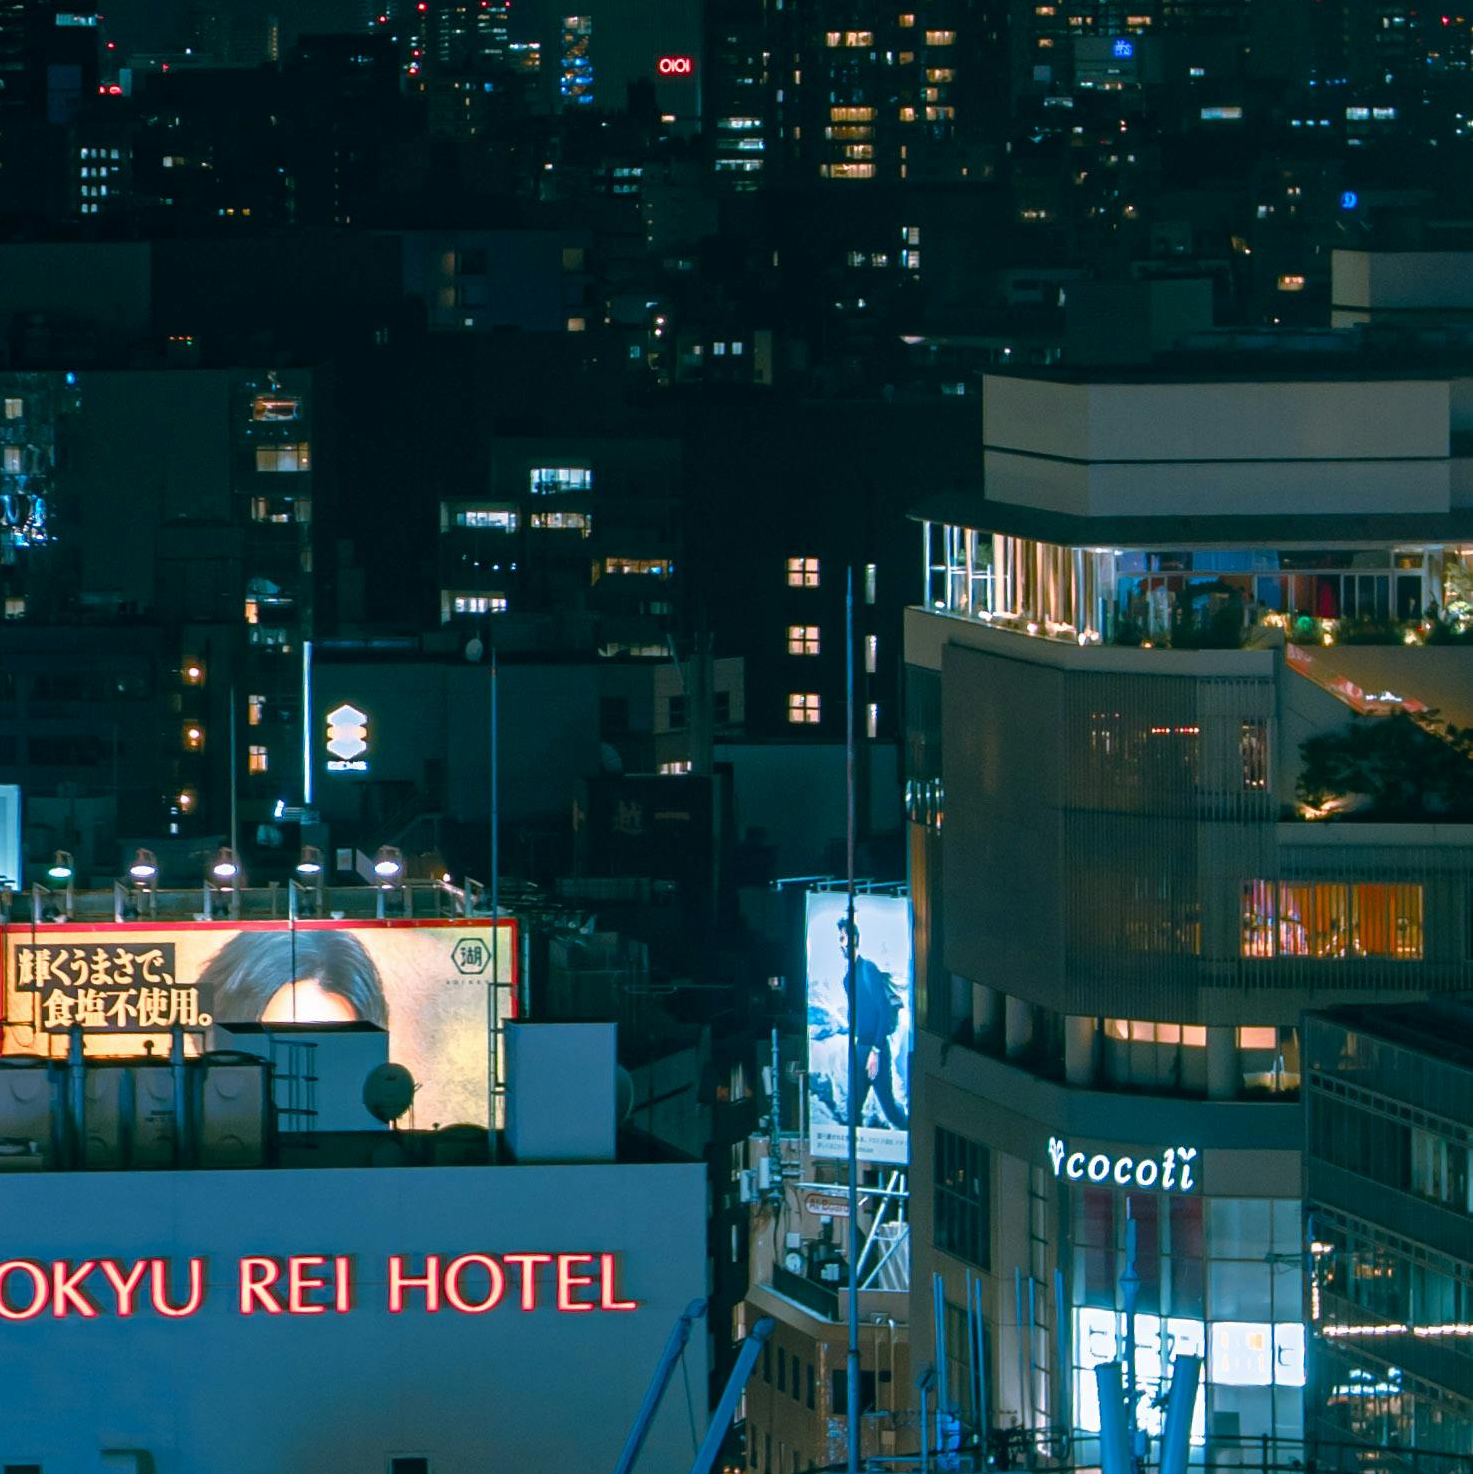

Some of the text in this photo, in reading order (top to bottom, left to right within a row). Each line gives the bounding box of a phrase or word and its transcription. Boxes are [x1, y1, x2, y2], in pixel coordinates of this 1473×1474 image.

[18, 947, 174, 987] 輝くうまさで、
[42, 987, 213, 1027] 食塩不使用。
[1066, 1146, 1197, 1191] cocoti
[239, 1256, 351, 1315] REI
[388, 1253, 639, 1314] HOTEL
